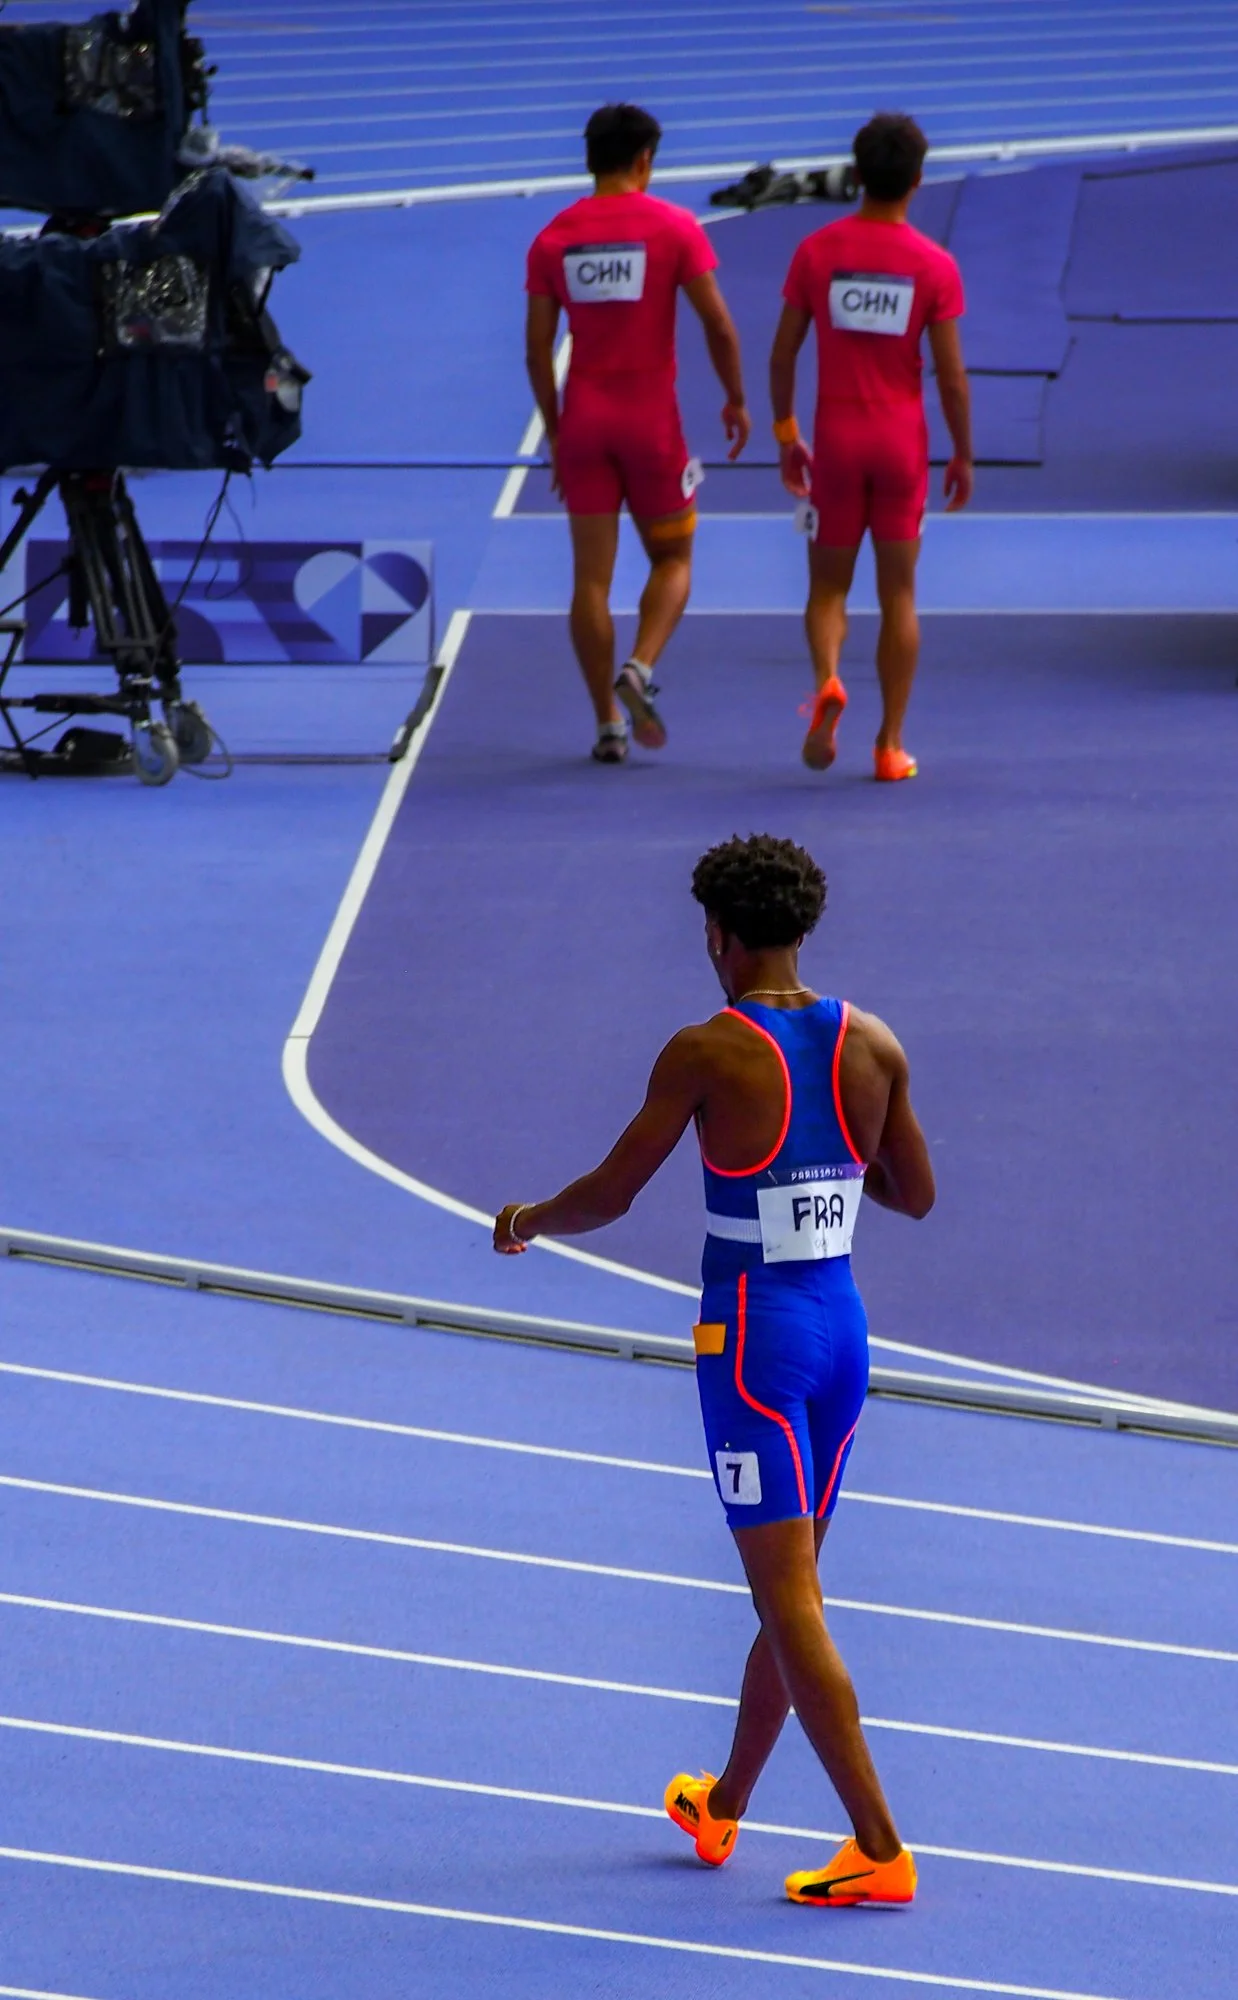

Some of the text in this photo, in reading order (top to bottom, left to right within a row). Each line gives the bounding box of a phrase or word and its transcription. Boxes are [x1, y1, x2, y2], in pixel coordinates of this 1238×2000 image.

[577, 259, 631, 285] CHN
[842, 288, 899, 316] CHN
[792, 1193, 844, 1232] FRA
[726, 1463, 742, 1494] 7
